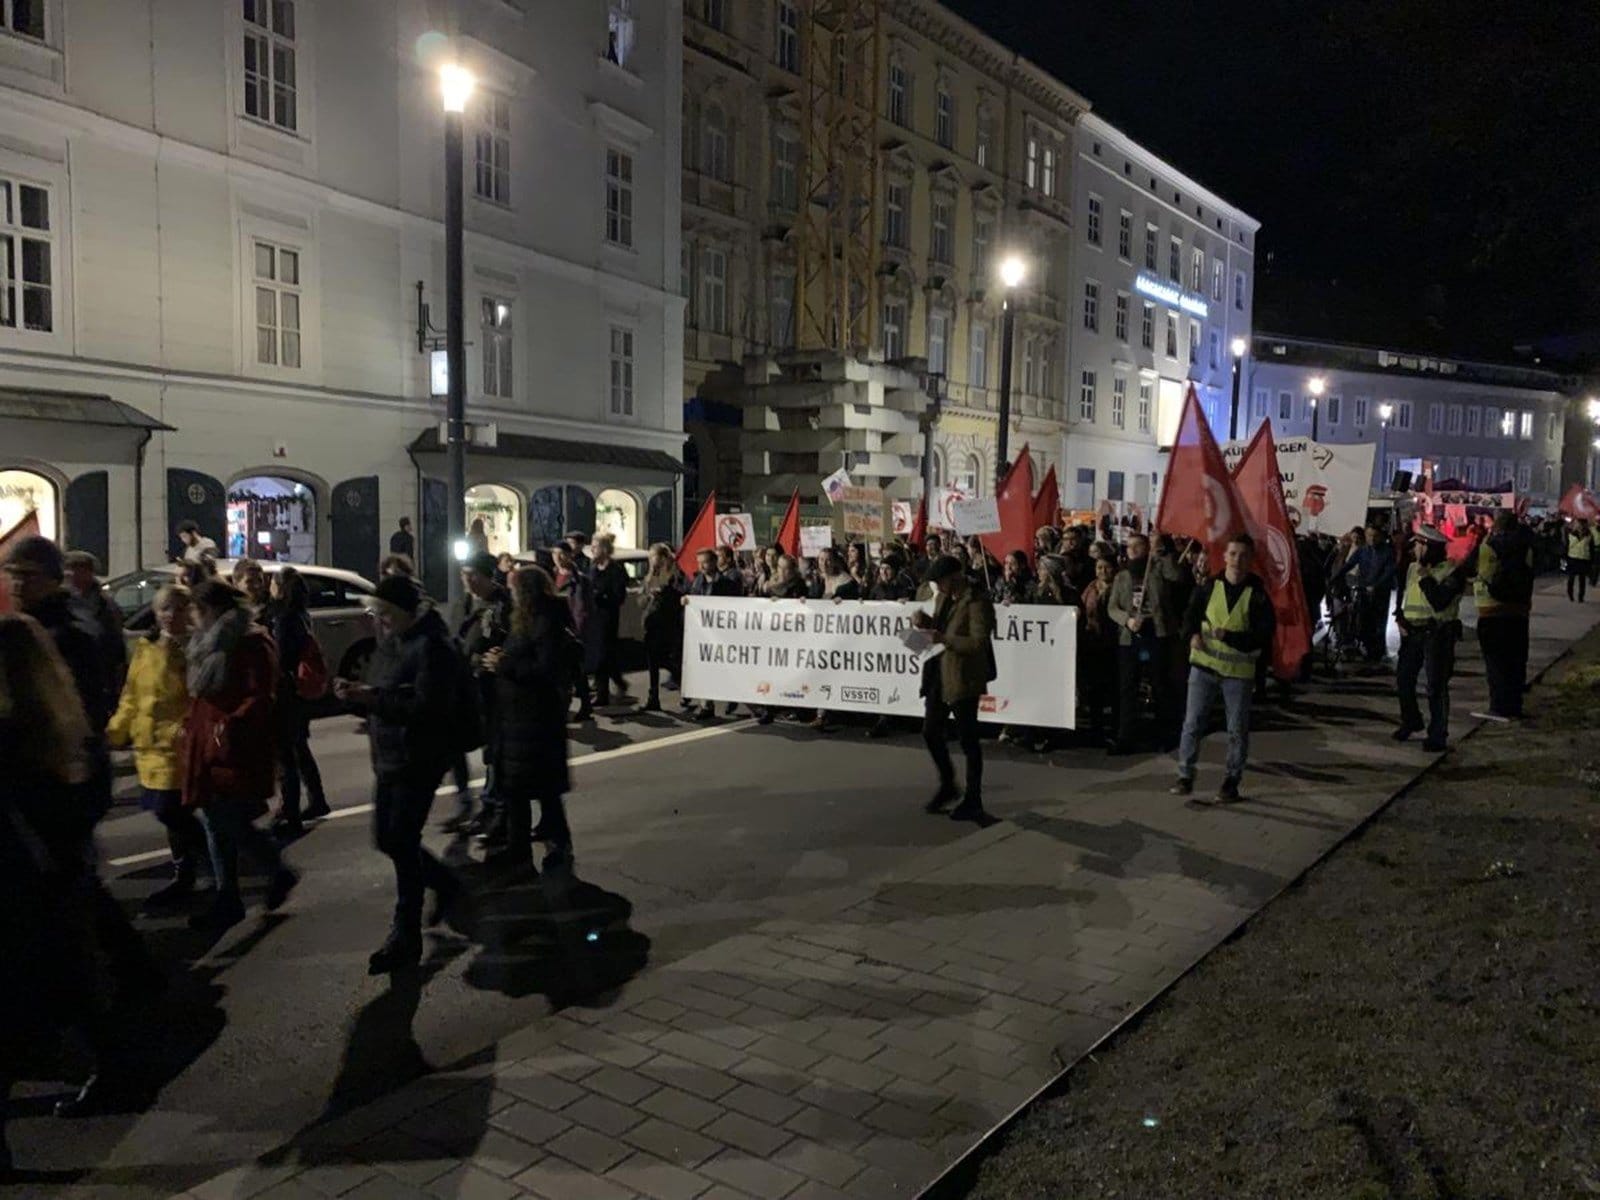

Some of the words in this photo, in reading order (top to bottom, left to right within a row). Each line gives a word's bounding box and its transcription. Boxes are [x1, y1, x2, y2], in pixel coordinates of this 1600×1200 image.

[700, 609, 737, 630] WER
[745, 611, 763, 631] IN
[770, 611, 806, 633] DER
[993, 614, 1055, 647] LÄFT,
[699, 643, 761, 665] WACHT
[768, 648, 788, 667] IM
[796, 648, 921, 675] FASCHISMUS
